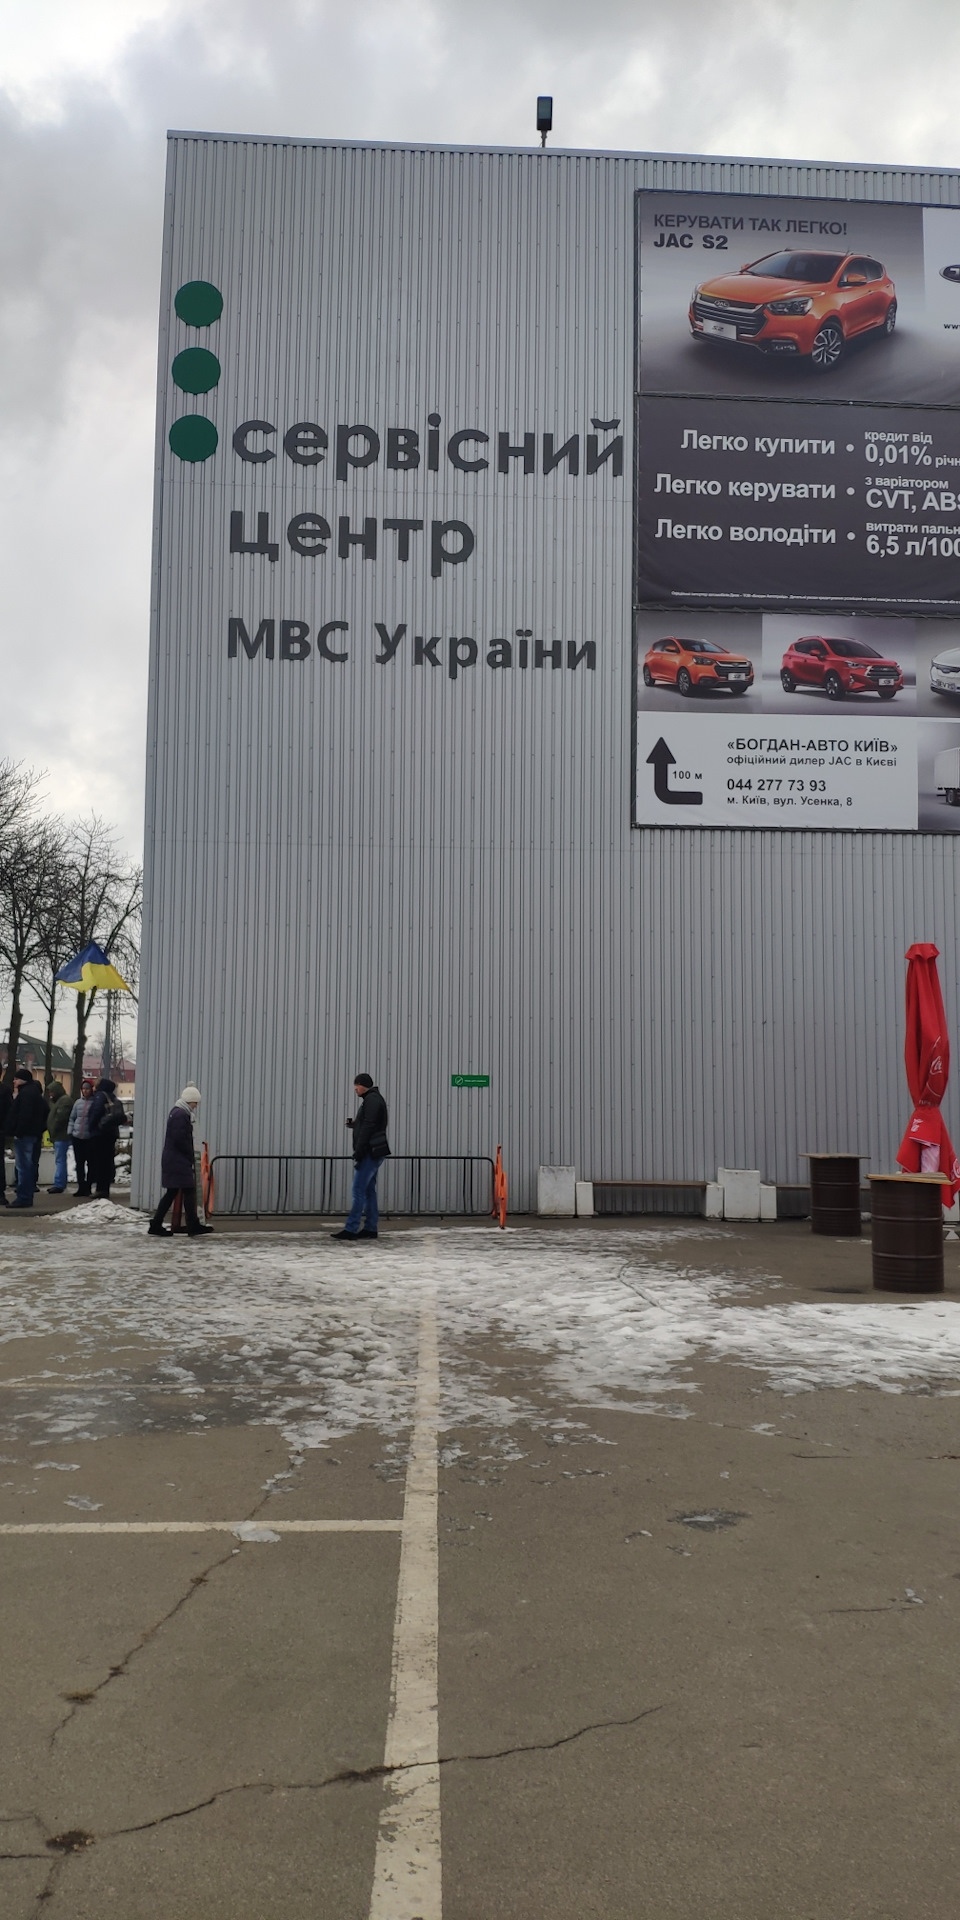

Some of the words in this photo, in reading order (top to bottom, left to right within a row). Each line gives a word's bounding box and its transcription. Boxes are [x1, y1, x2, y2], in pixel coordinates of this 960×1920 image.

[653, 214, 744, 230] КЕРУВАТИ
[749, 218, 782, 232] ТАК
[785, 219, 847, 235] ЛЕГКО!
[653, 233, 693, 248] JAC
[702, 234, 728, 250] S2
[232, 412, 623, 481] сервісний
[681, 429, 749, 451] Легко
[755, 437, 835, 457] купити
[864, 431, 909, 443] кредит
[912, 432, 933, 444] від
[865, 443, 933, 466] 0,01%
[654, 473, 722, 495] Легко
[728, 481, 836, 502] керувати
[875, 476, 949, 491] варіатором
[866, 488, 917, 513] CVT,
[921, 491, 960, 511] AB
[655, 518, 723, 541] Легко
[729, 524, 836, 546] володіти
[866, 522, 918, 535] витрати
[229, 510, 475, 577] центр
[866, 534, 900, 558] 6,5
[227, 617, 349, 662] МВС
[374, 622, 597, 679] України
[727, 738, 849, 752] «БОГДАН-АВТО
[853, 738, 898, 752] КИЇВ»
[726, 755, 786, 766] офіційний
[789, 758, 825, 767] дилер
[828, 756, 852, 766] JAC
[866, 757, 897, 767] Києві
[672, 770, 691, 780] 100
[727, 779, 752, 791] 044
[757, 779, 783, 791] 277
[787, 780, 805, 792] 73
[809, 780, 827, 792] 93
[727, 797, 738, 805] м.
[742, 796, 770, 806] Київ,
[773, 798, 797, 807] вул.
[800, 796, 843, 808] Усенка,
[846, 797, 853, 807] 8
